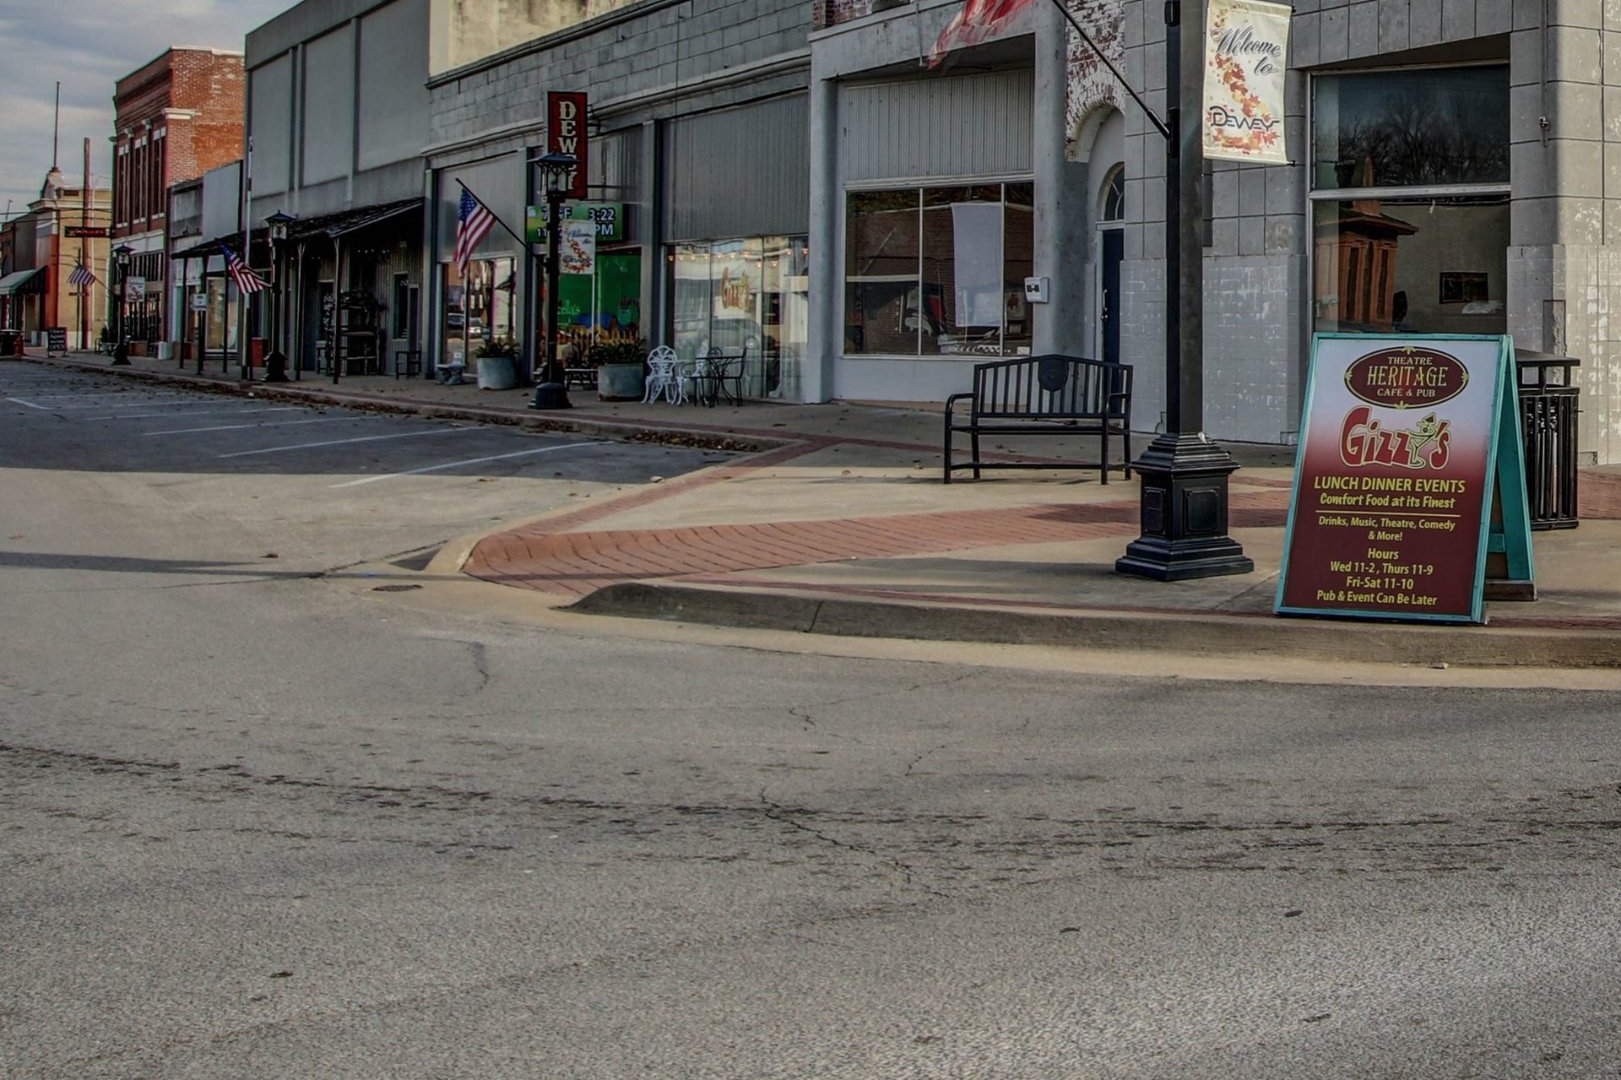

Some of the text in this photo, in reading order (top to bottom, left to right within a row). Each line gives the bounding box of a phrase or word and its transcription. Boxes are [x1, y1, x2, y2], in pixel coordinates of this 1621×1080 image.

[1213, 26, 1282, 57] Welcome
[1254, 56, 1279, 76] to
[1387, 356, 1433, 365] THEATRE
[1366, 366, 1448, 387] HERITAGE
[1405, 388, 1413, 397] &
[1416, 389, 1436, 397] PUB
[1314, 476, 1466, 493] LUNCH DINNER EVENTS
[1320, 492, 1456, 508] Comfort Food at its Finest
[1318, 516, 1456, 532] Drinks, Music, Theatre, Comedy
[1368, 531, 1403, 541] & More!
[1367, 548, 1399, 560] Hours
[1330, 561, 1352, 572] Wed
[1382, 563, 1409, 575] Thurs
[1412, 564, 1434, 575] 11-9
[1346, 576, 1414, 590] Fri-Sat 11-10
[1316, 589, 1438, 606] Pub & Event Can Be Later
